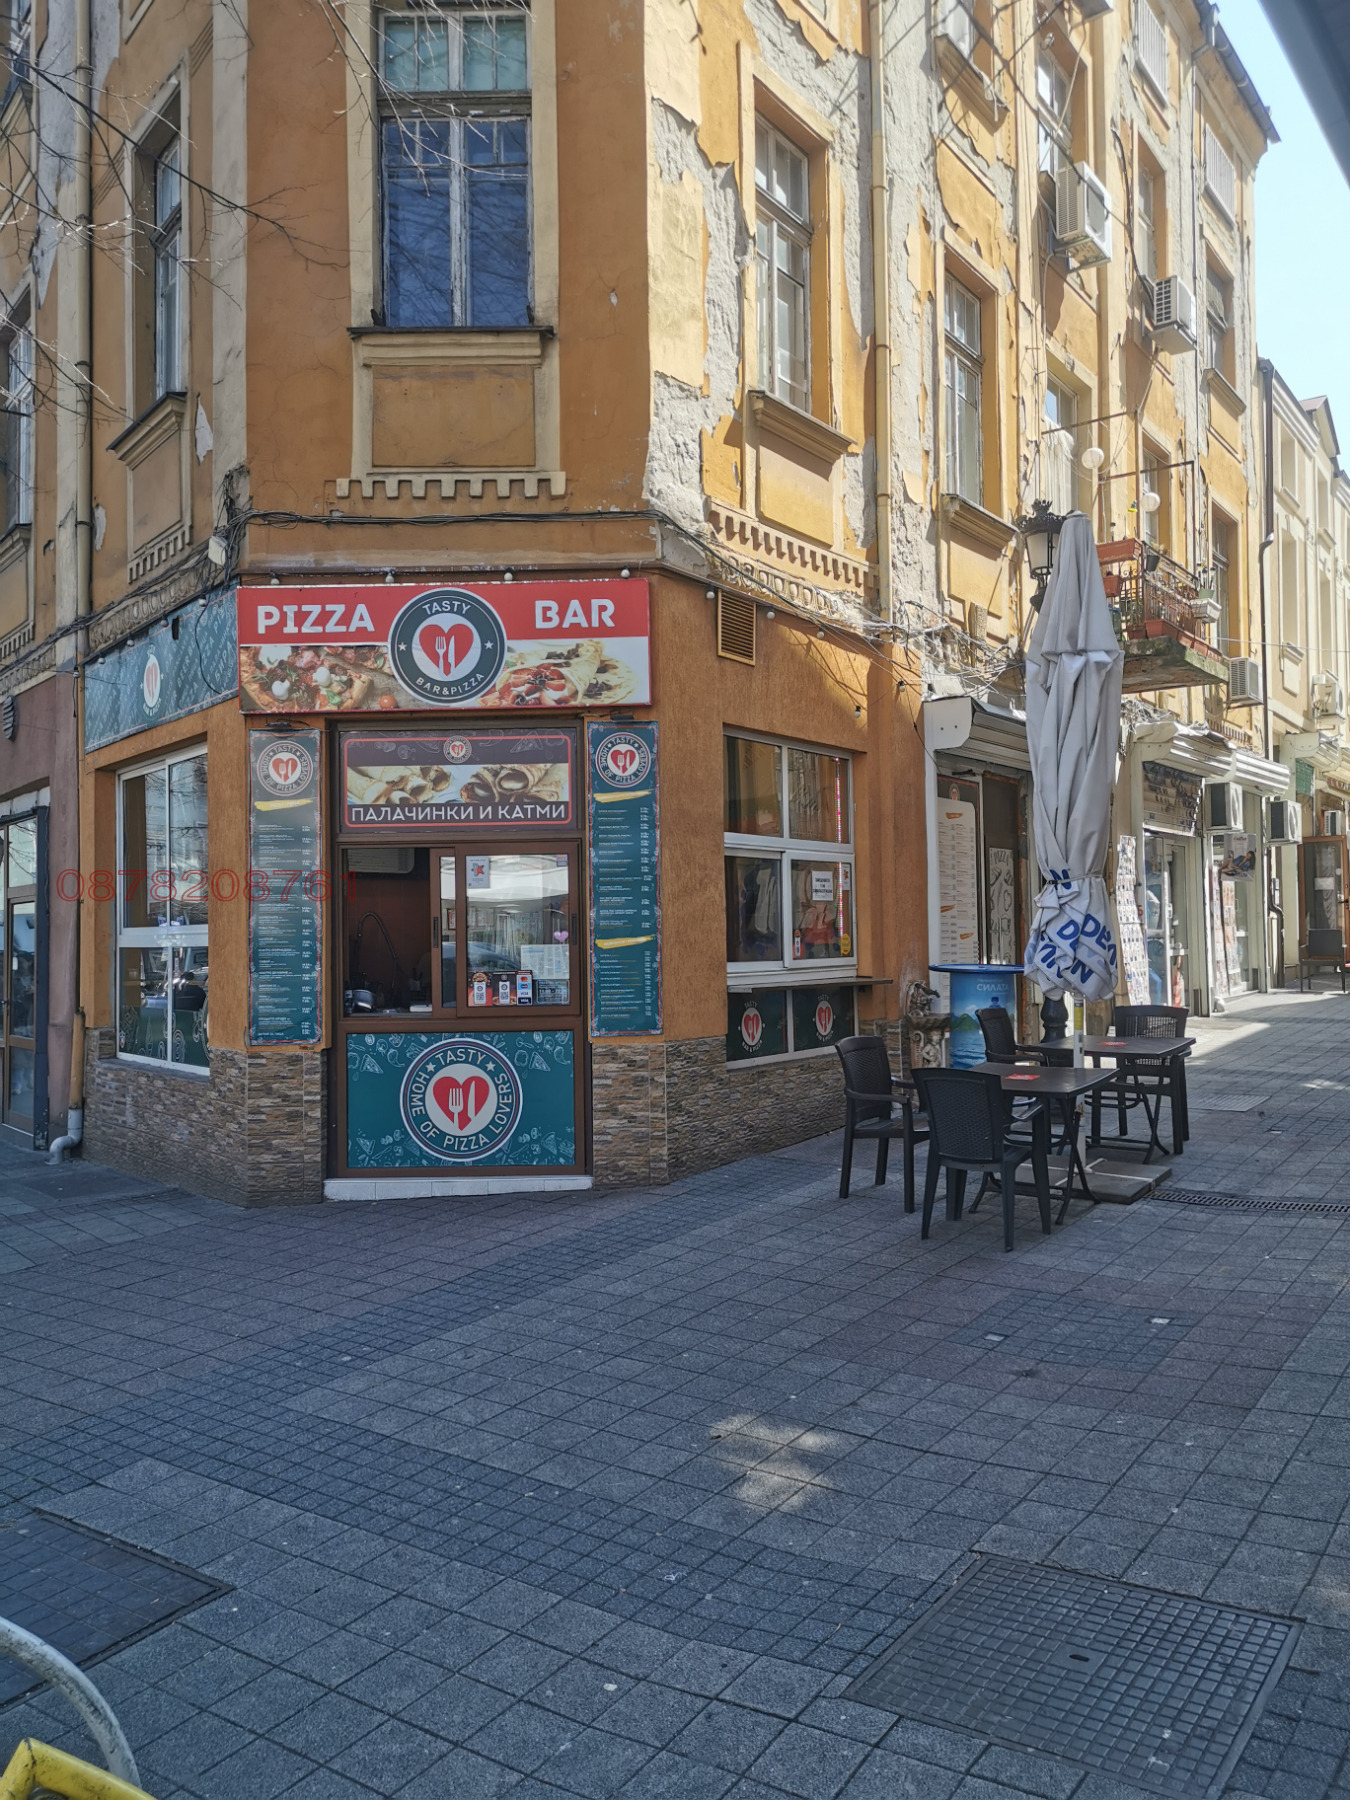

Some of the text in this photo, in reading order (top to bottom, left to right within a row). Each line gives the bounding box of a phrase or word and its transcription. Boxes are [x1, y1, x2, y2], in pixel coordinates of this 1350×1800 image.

[422, 600, 472, 615] TASTY
[256, 603, 375, 635] PIZZA
[534, 598, 616, 629] BAR
[612, 736, 635, 745] TASTY
[274, 745, 296, 754] TASTY
[615, 775, 636, 784] PIZZA
[276, 784, 298, 792] PIZZA
[351, 804, 566, 822] ПАЛАЧИНКИ И КАТМИ
[976, 983, 1009, 991] СИЛАТА
[435, 1049, 487, 1066] TASTY
[410, 1071, 512, 1151] HOME OF PIZZA LOVERS
